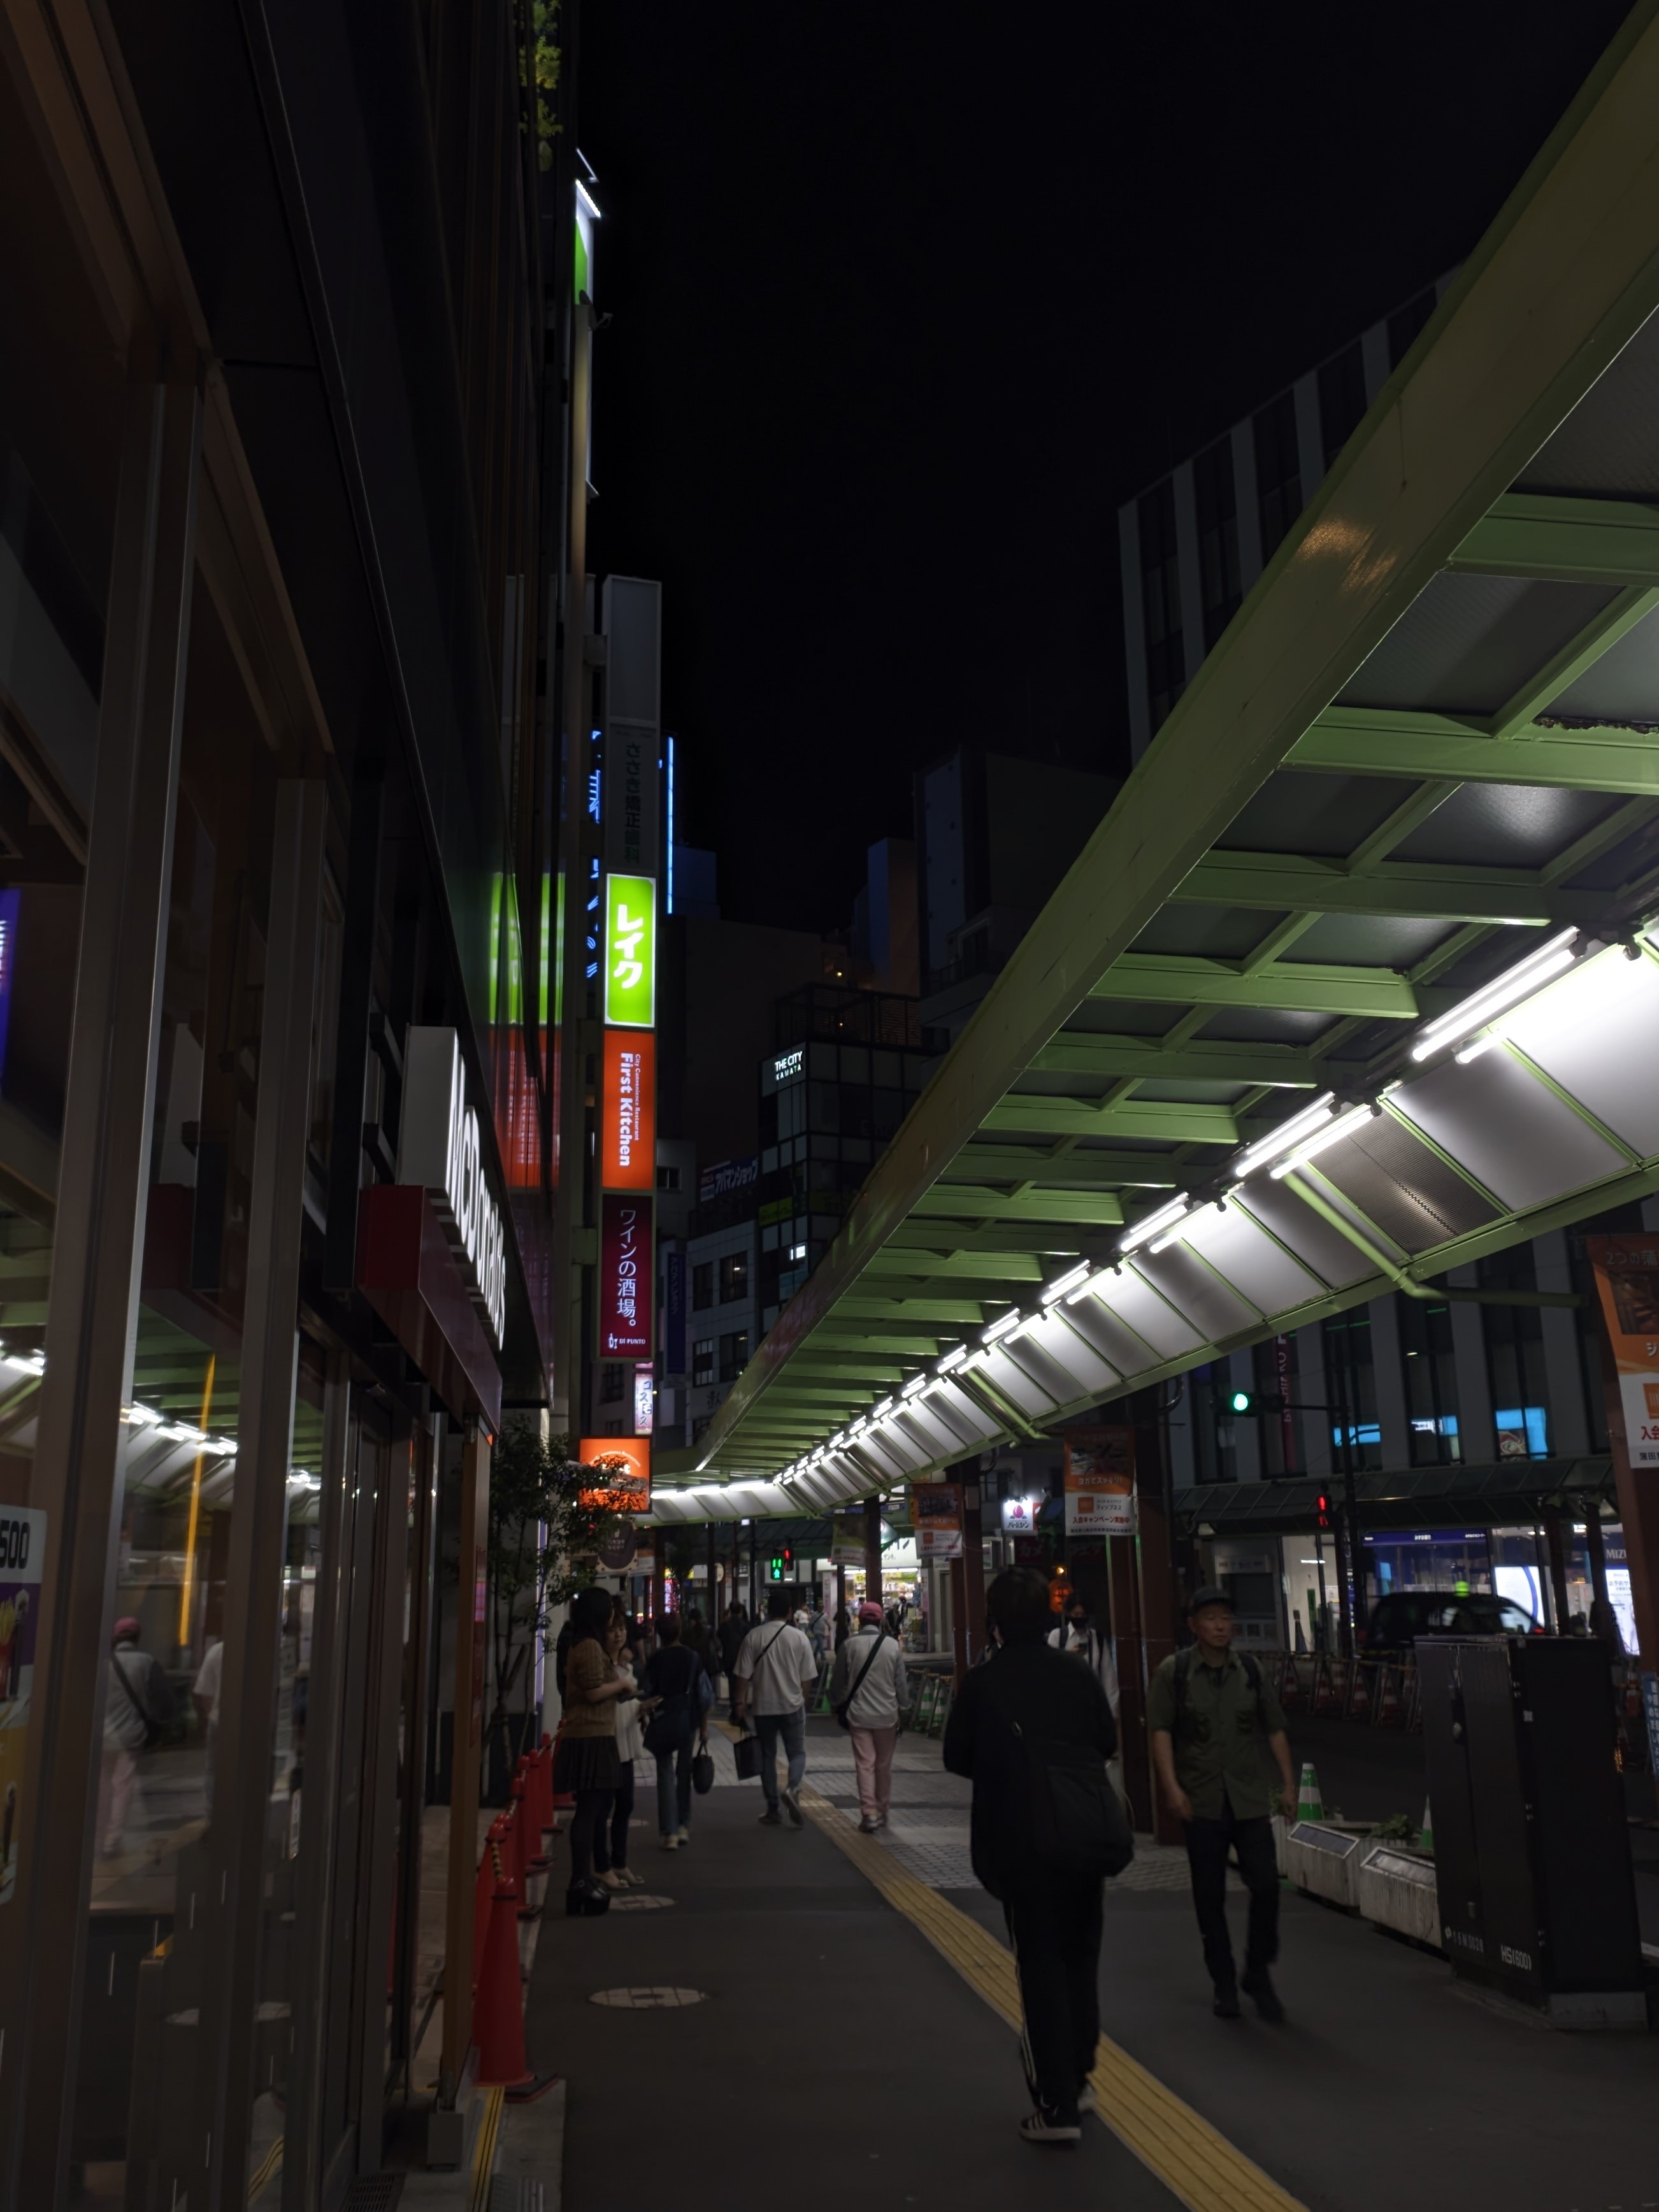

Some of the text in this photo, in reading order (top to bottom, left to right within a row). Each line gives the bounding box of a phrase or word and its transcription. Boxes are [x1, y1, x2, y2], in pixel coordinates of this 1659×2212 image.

[624, 741, 642, 865] ささき矯正歯科
[614, 903, 645, 989] レイク
[775, 1050, 803, 1072] THE CITY
[775, 1063, 801, 1081] KAMATA
[619, 1052, 633, 1167] First Kitchen
[715, 1156, 759, 1195] アパマンショップ
[616, 1209, 636, 1326] ワインの酒場。
[638, 1381, 652, 1426] コスモス
[1639, 1451, 1659, 1461] 蒲田
